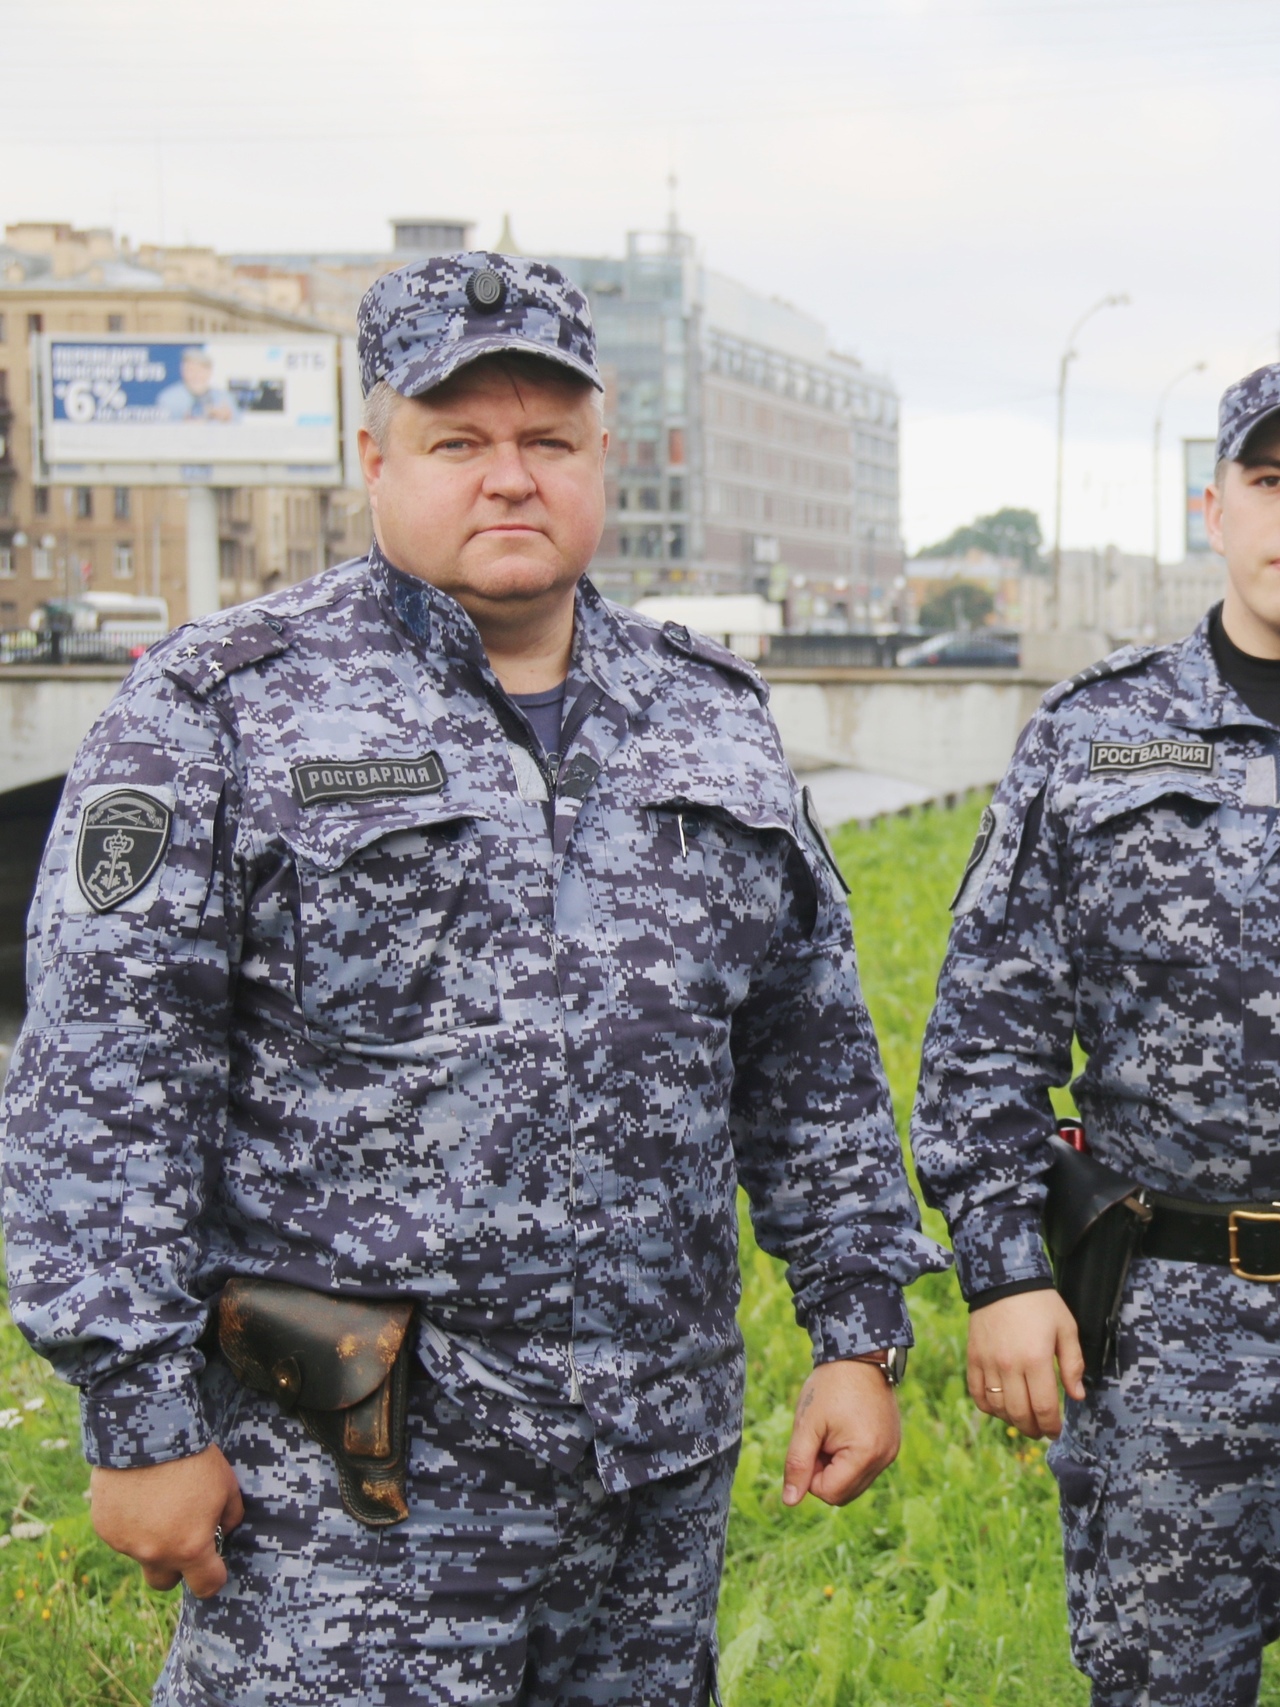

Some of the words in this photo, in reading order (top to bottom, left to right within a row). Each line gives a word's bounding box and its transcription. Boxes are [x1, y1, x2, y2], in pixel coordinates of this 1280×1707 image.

[286, 352, 326, 372] ВТБ
[1097, 744, 1205, 764] РОСГВАРДИЯ
[308, 767, 430, 790] РОСГВАРДИЯ
